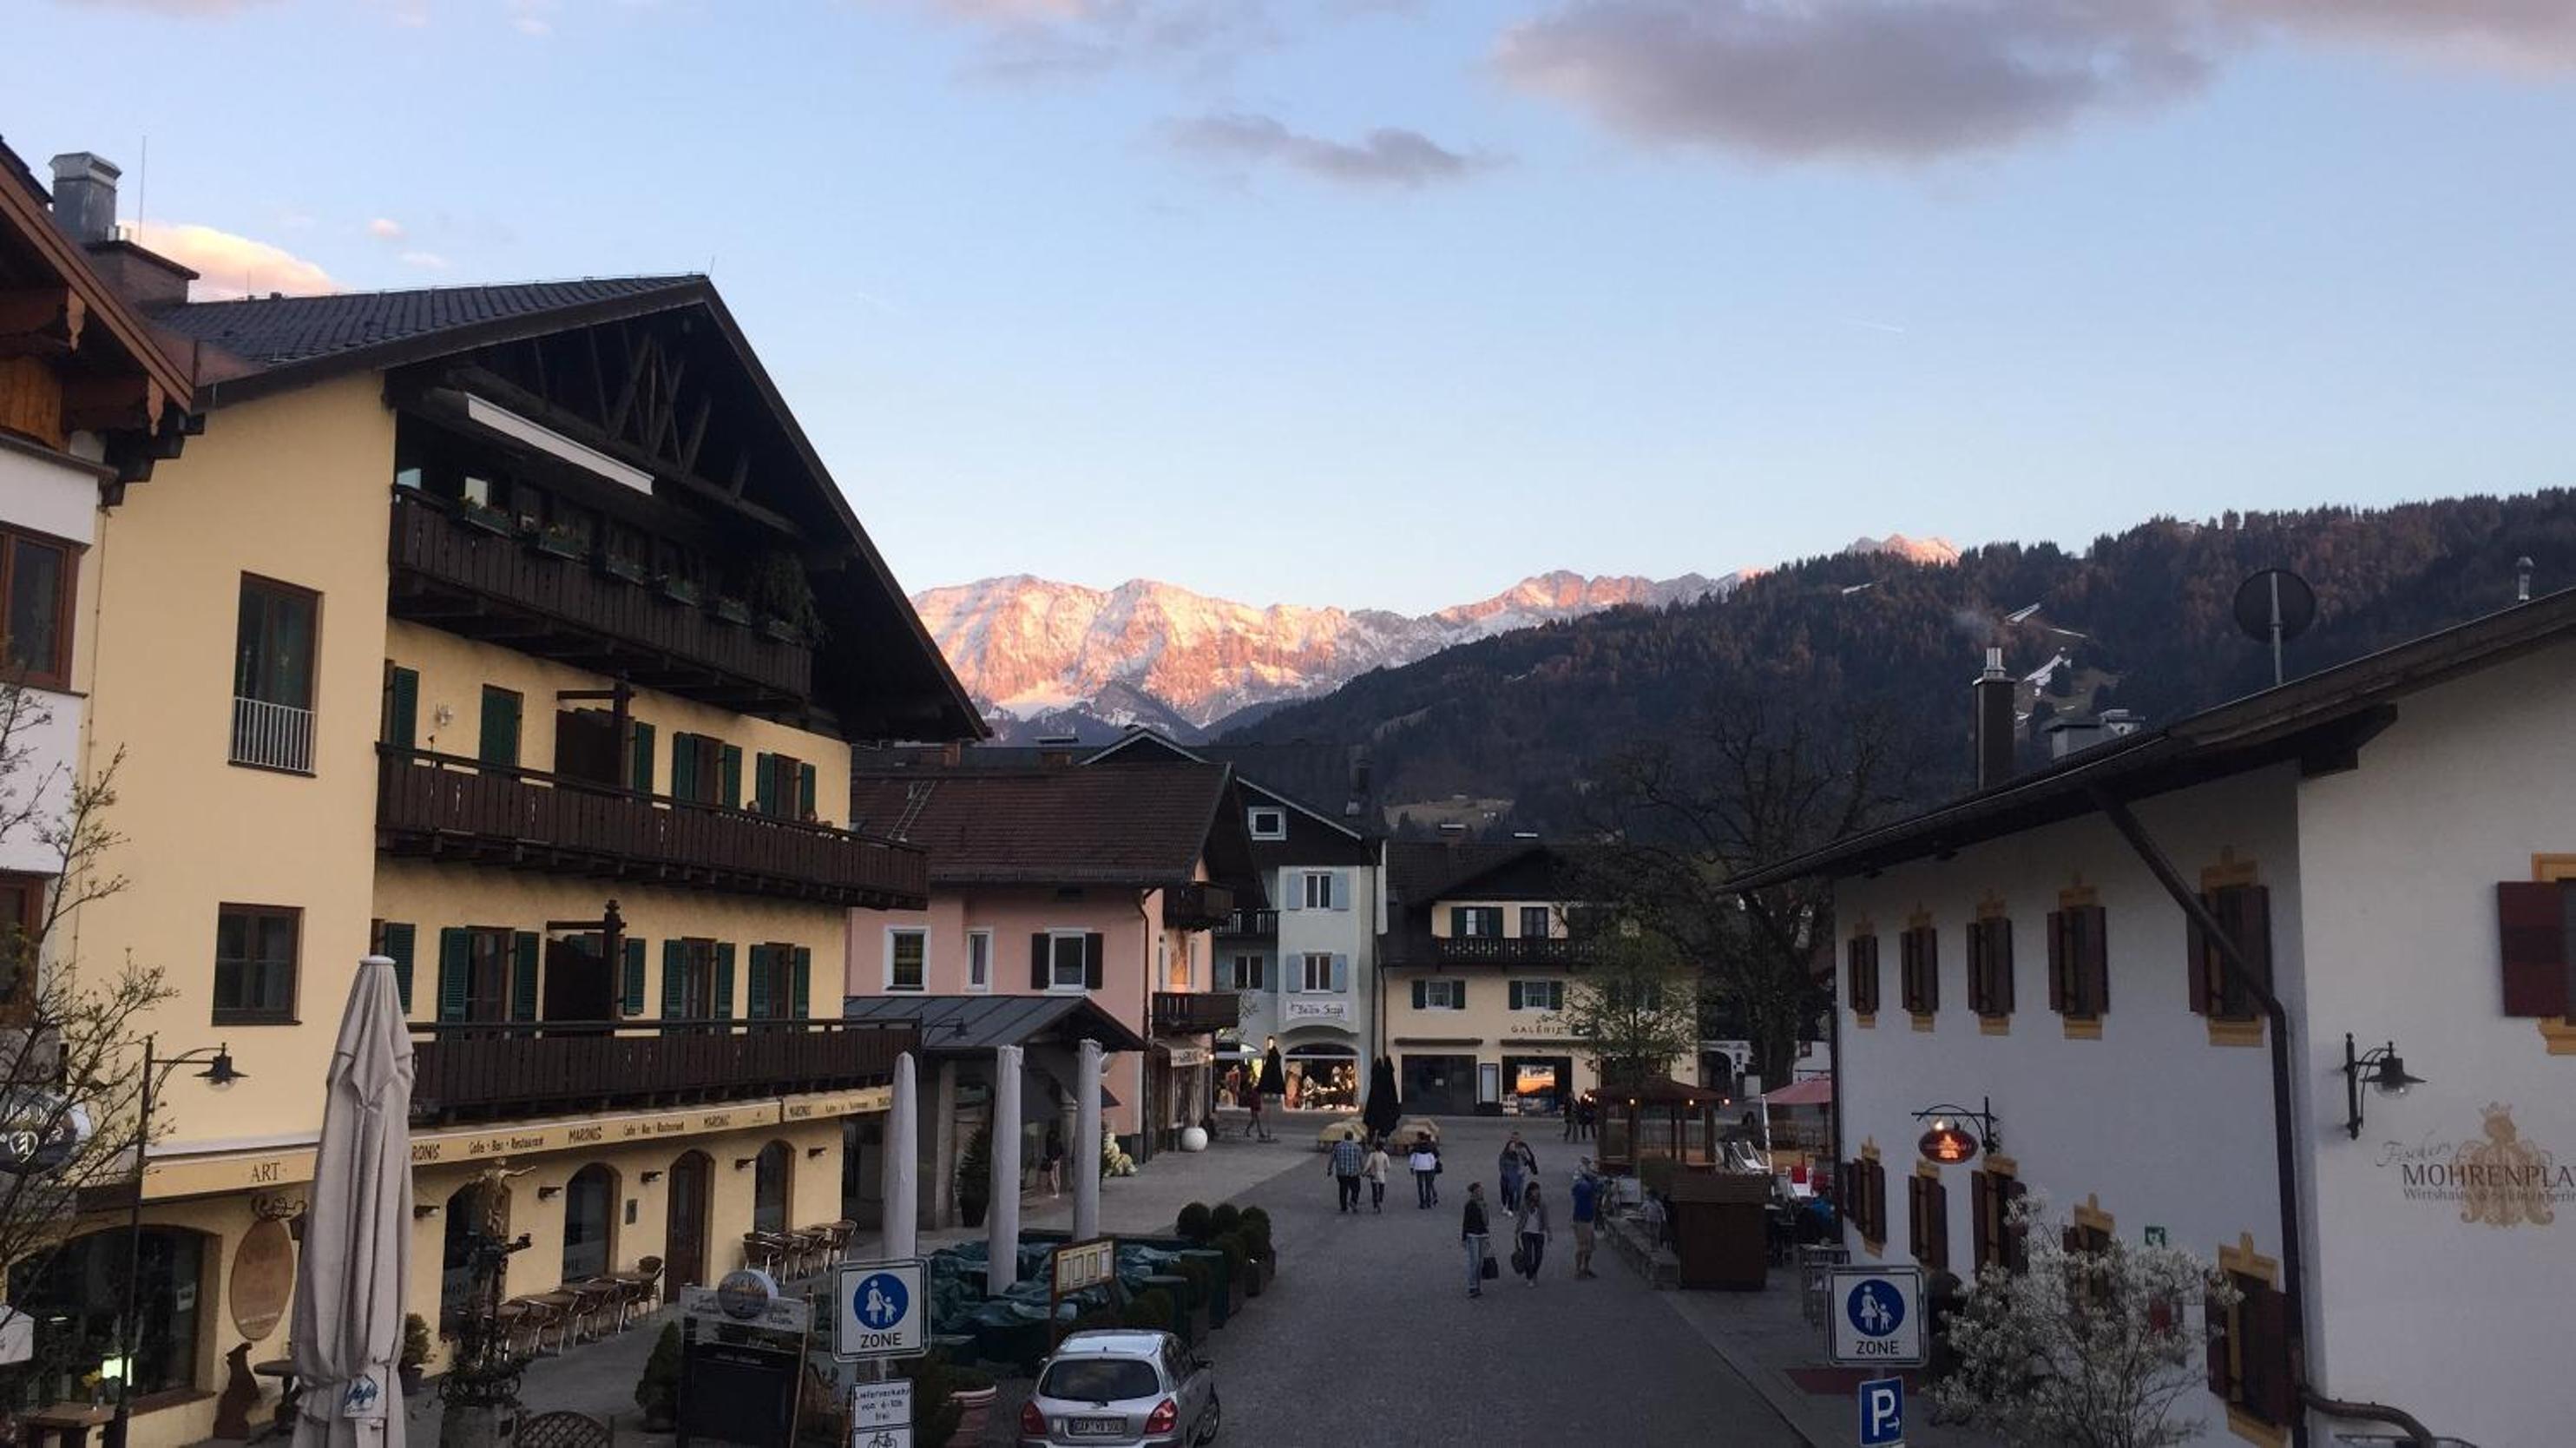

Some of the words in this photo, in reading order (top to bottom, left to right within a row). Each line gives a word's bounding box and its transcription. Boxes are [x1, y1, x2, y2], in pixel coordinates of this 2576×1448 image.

[411, 1143, 441, 1162] RONIS
[251, 1162, 281, 1182] ART
[2402, 1163, 2576, 1188] MOHRENPLA
[860, 1333, 903, 1348] ZONE
[1856, 1340, 1901, 1355] ZONE
[1871, 1389, 1896, 1437] P
